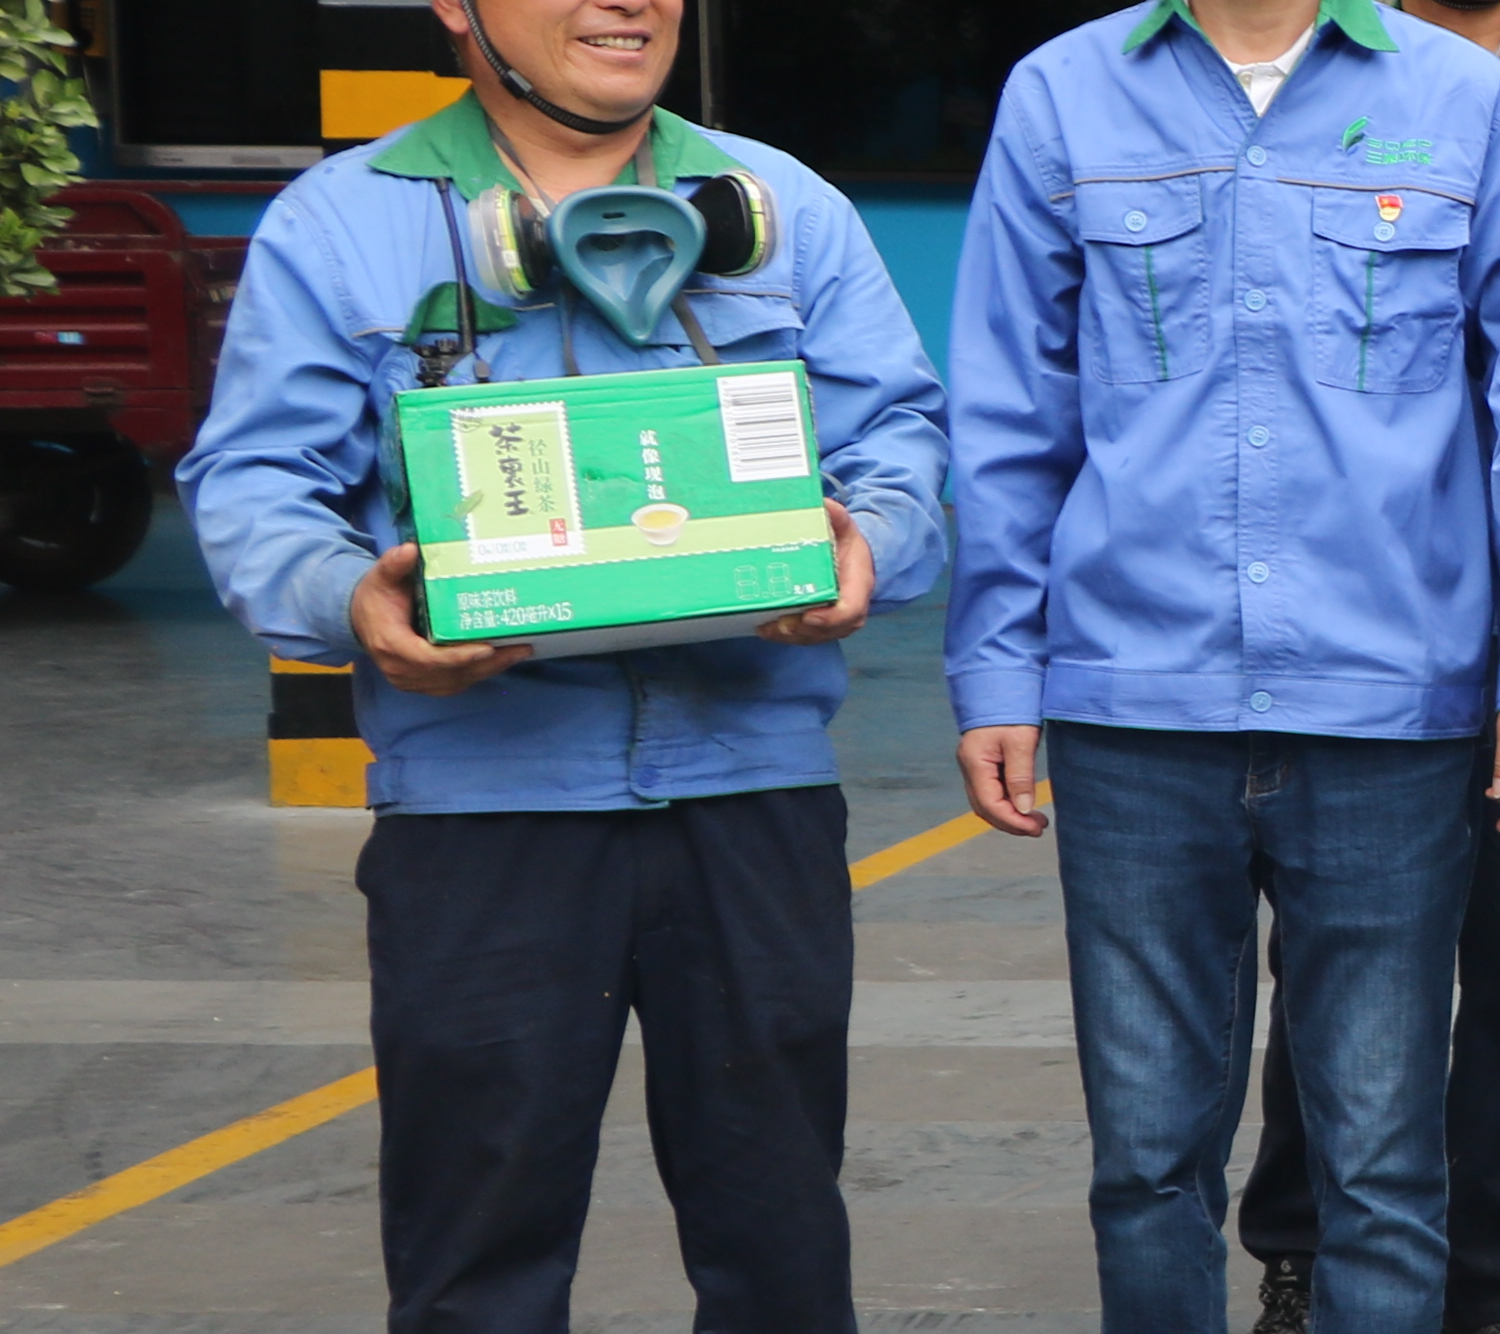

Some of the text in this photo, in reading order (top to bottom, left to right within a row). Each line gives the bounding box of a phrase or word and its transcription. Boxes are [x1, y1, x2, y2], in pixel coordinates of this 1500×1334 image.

[528, 438, 556, 513] 径山绿茶
[640, 429, 667, 500] 就像现泡
[456, 588, 517, 610] 原味茶饮料
